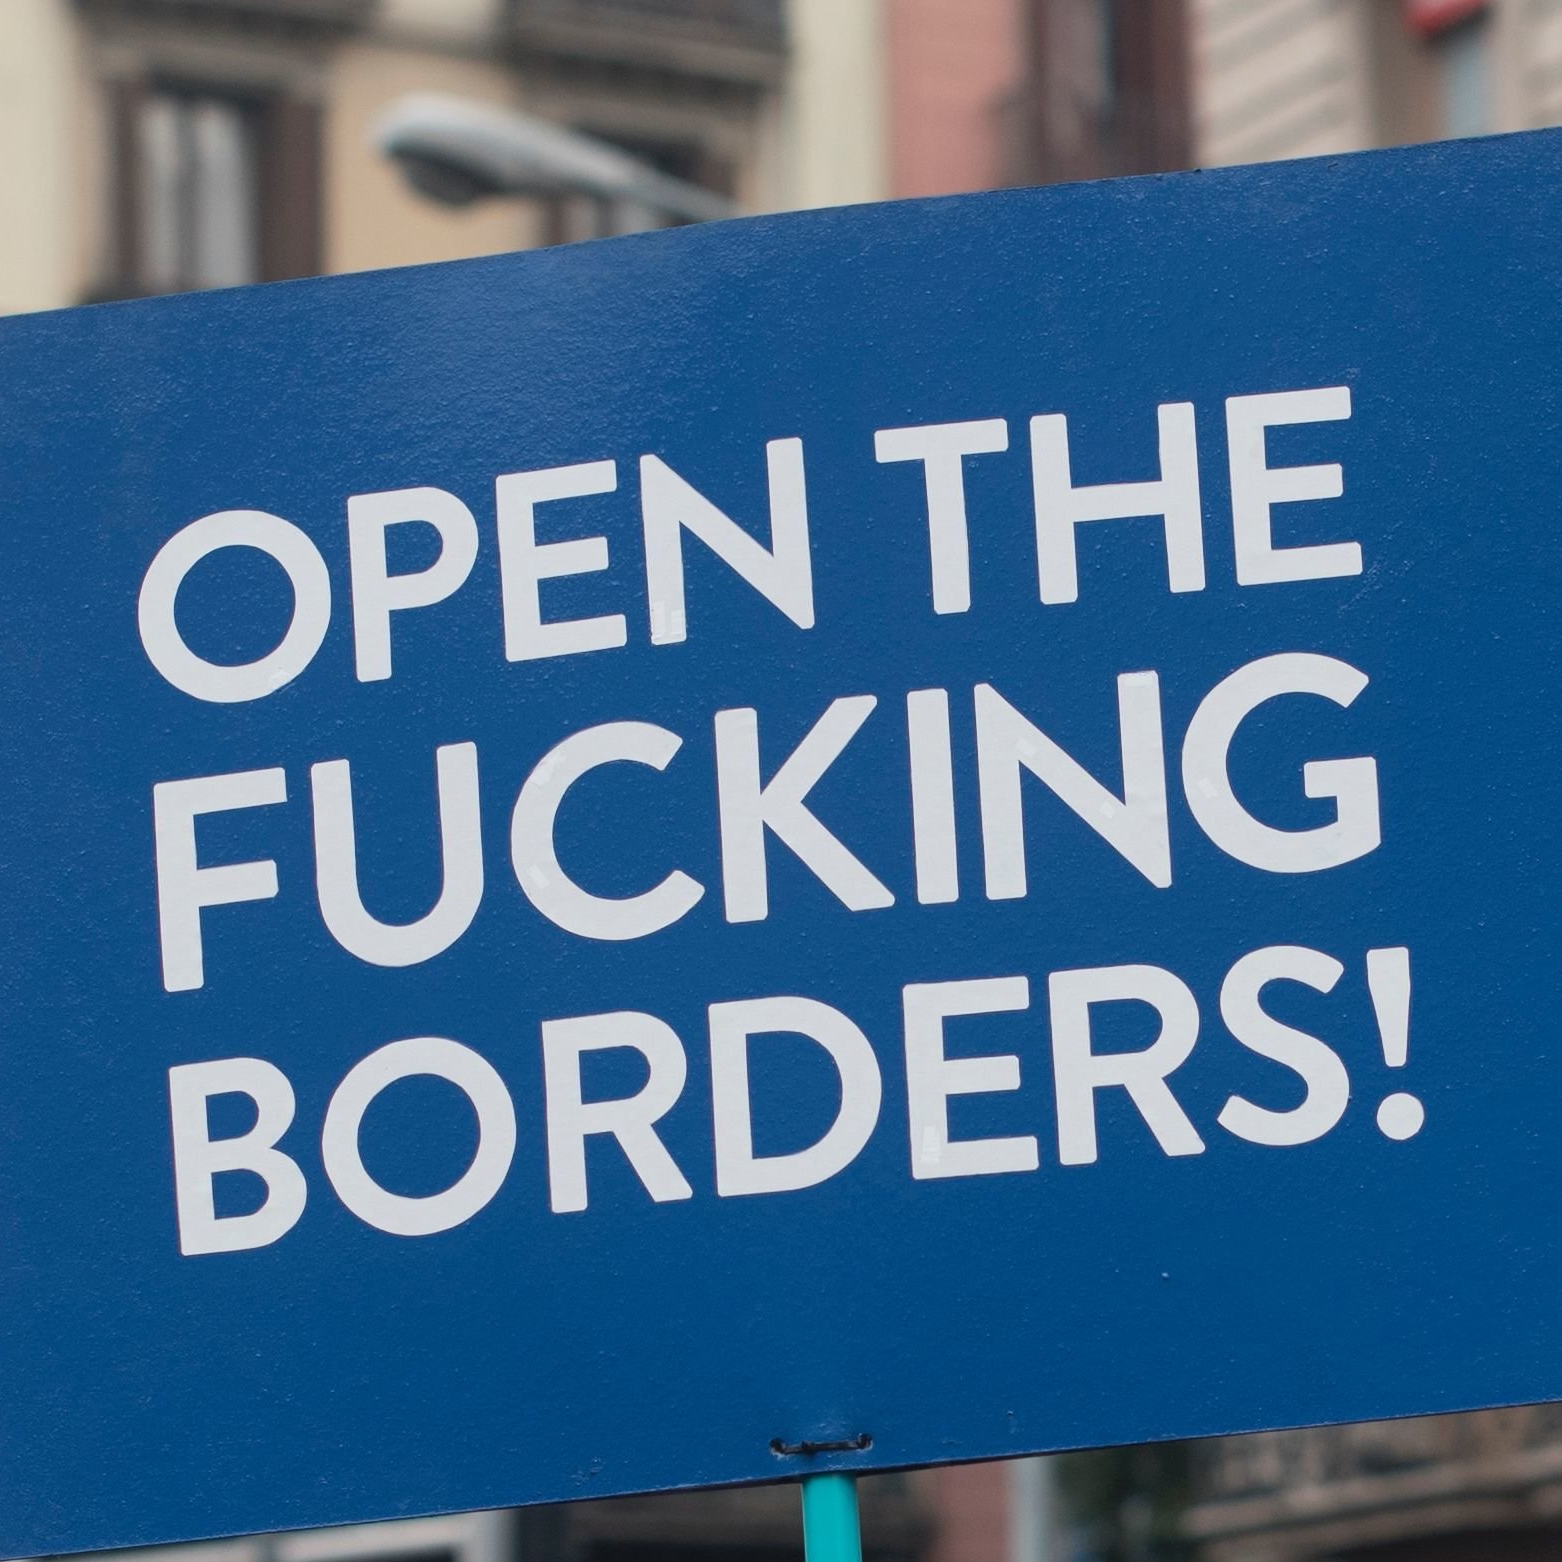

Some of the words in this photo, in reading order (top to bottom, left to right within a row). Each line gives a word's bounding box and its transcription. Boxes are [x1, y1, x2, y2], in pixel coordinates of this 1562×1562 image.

[137, 435, 815, 704] OPEN
[873, 385, 1363, 615] THE
[153, 652, 1382, 993] FUCKING
[168, 945, 1426, 1257] BORDERS!
